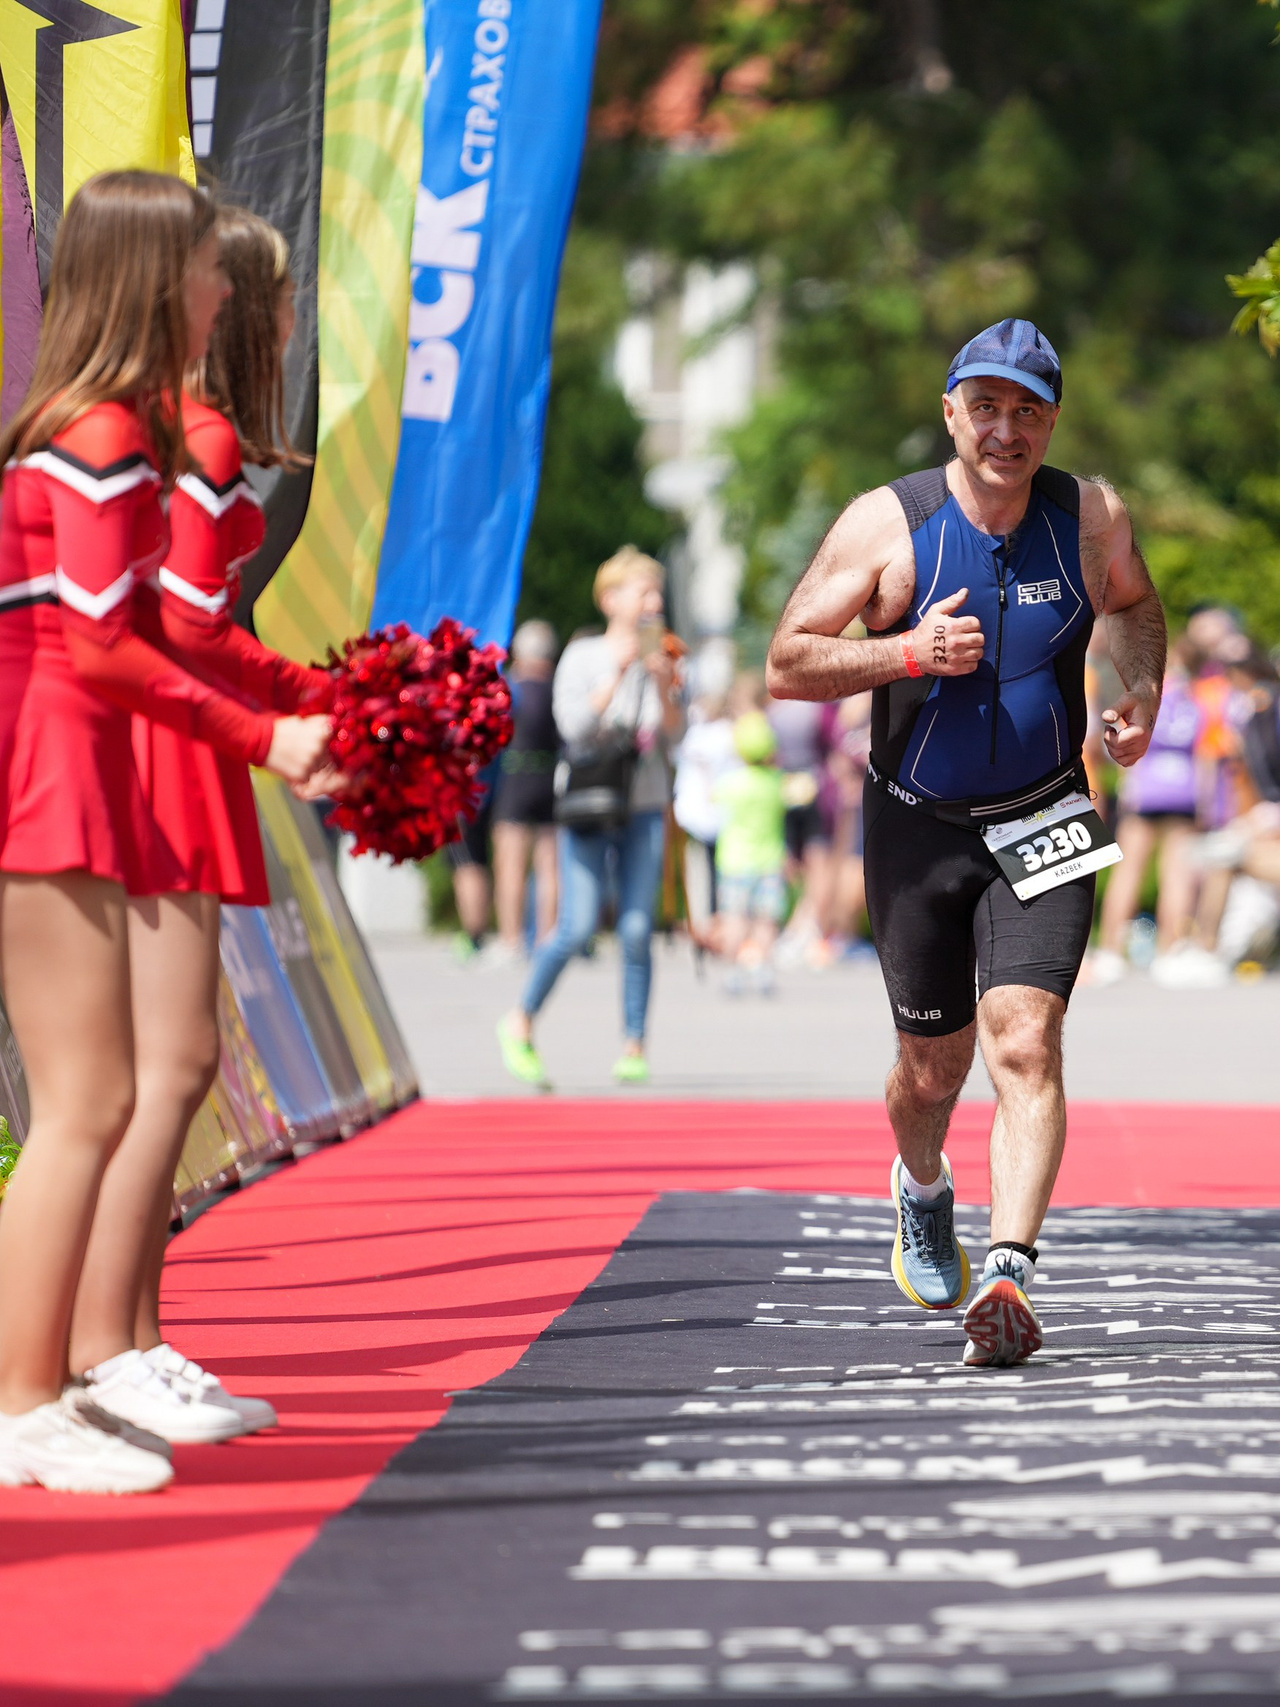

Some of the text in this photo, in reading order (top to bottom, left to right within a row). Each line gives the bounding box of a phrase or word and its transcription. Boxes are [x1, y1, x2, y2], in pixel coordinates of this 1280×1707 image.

[402, 179, 489, 423] ВСК
[1018, 591, 1062, 606] HUUB
[932, 625, 948, 664] 3230
[1016, 821, 1092, 872] 3230
[1054, 861, 1084, 878] KAZBEK
[897, 1003, 942, 1020] HUUB
[704, 1375, 1024, 1391] IRON
[676, 1397, 1019, 1412] IRON
[638, 1456, 1022, 1477] IRON
